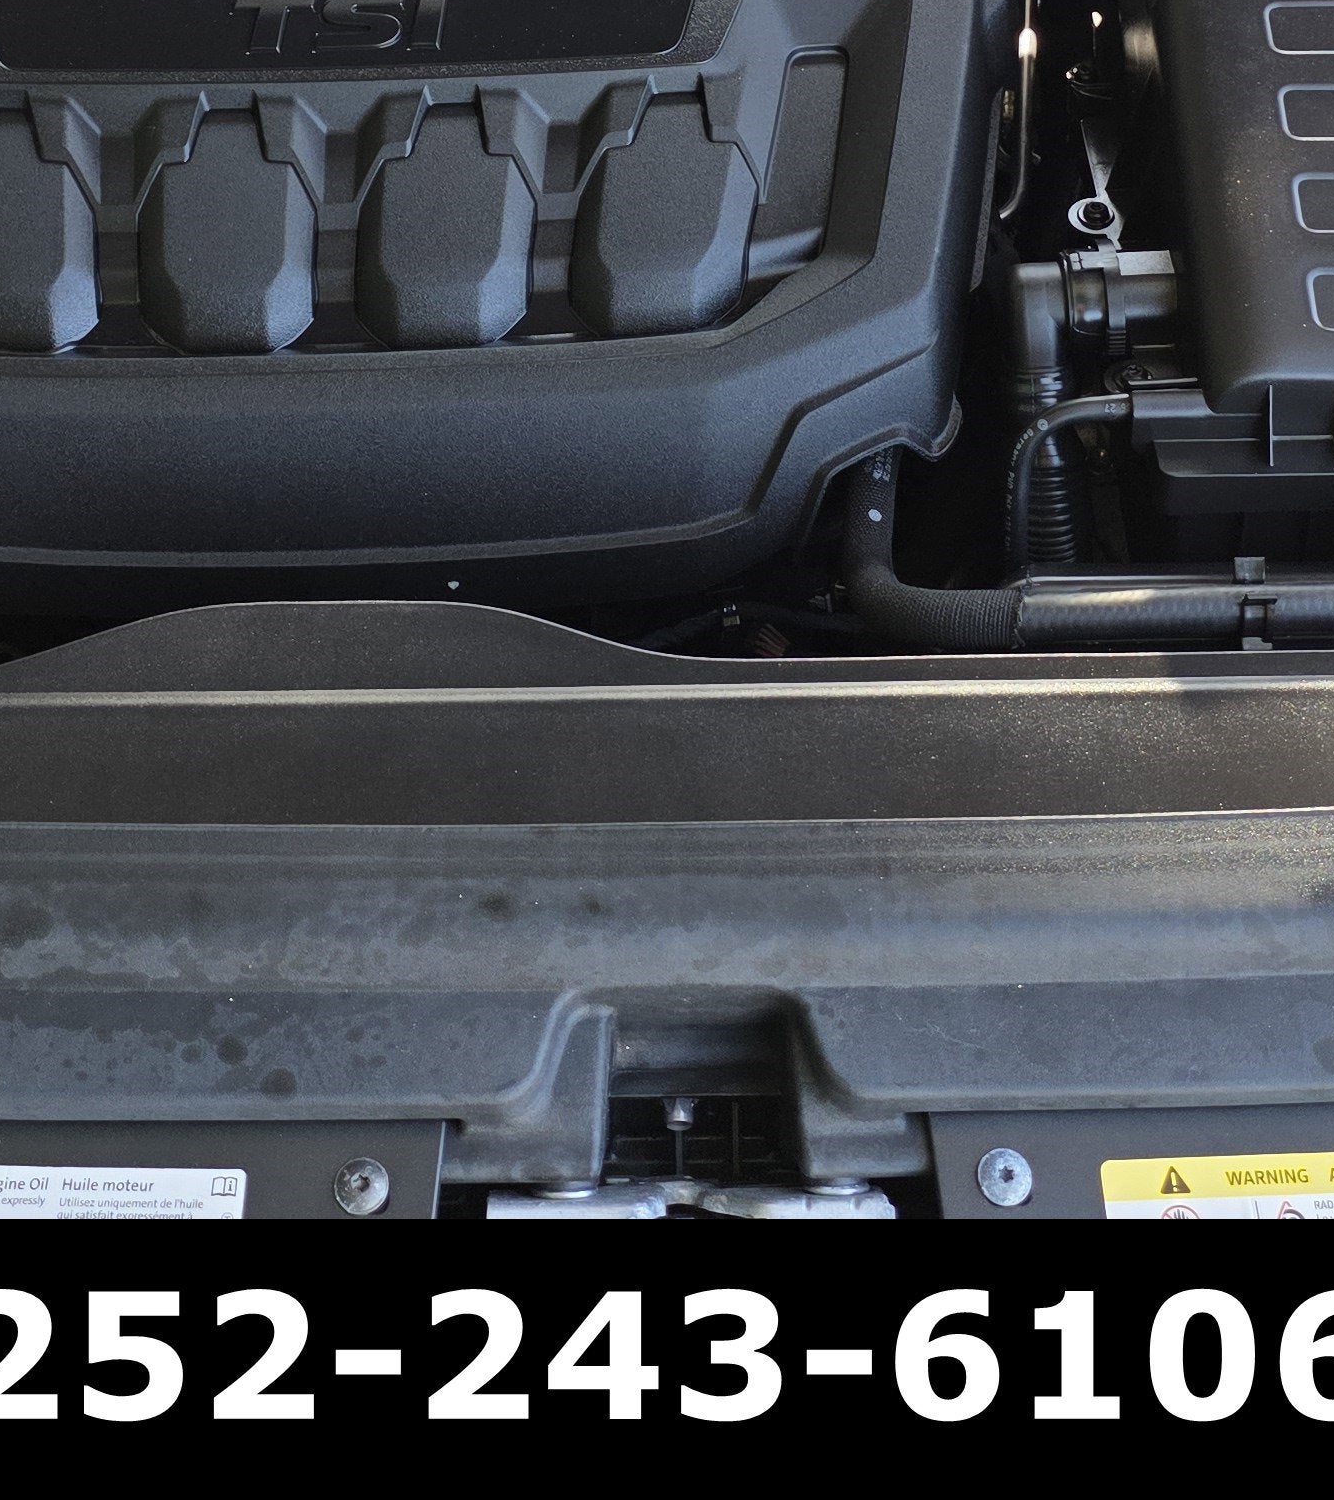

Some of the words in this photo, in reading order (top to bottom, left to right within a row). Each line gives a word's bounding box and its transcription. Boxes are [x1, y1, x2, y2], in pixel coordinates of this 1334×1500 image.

[29, 1177, 49, 1190] Oil
[1225, 1169, 1309, 1186] WARNING
[62, 1178, 98, 1191] Huile
[102, 1180, 154, 1192] moteur
[1, 1196, 45, 1207] expressly
[59, 1197, 94, 1207] Utilisez
[97, 1198, 158, 1210] uniquement
[159, 1199, 172, 1208] de
[174, 1199, 204, 1209] l'huile
